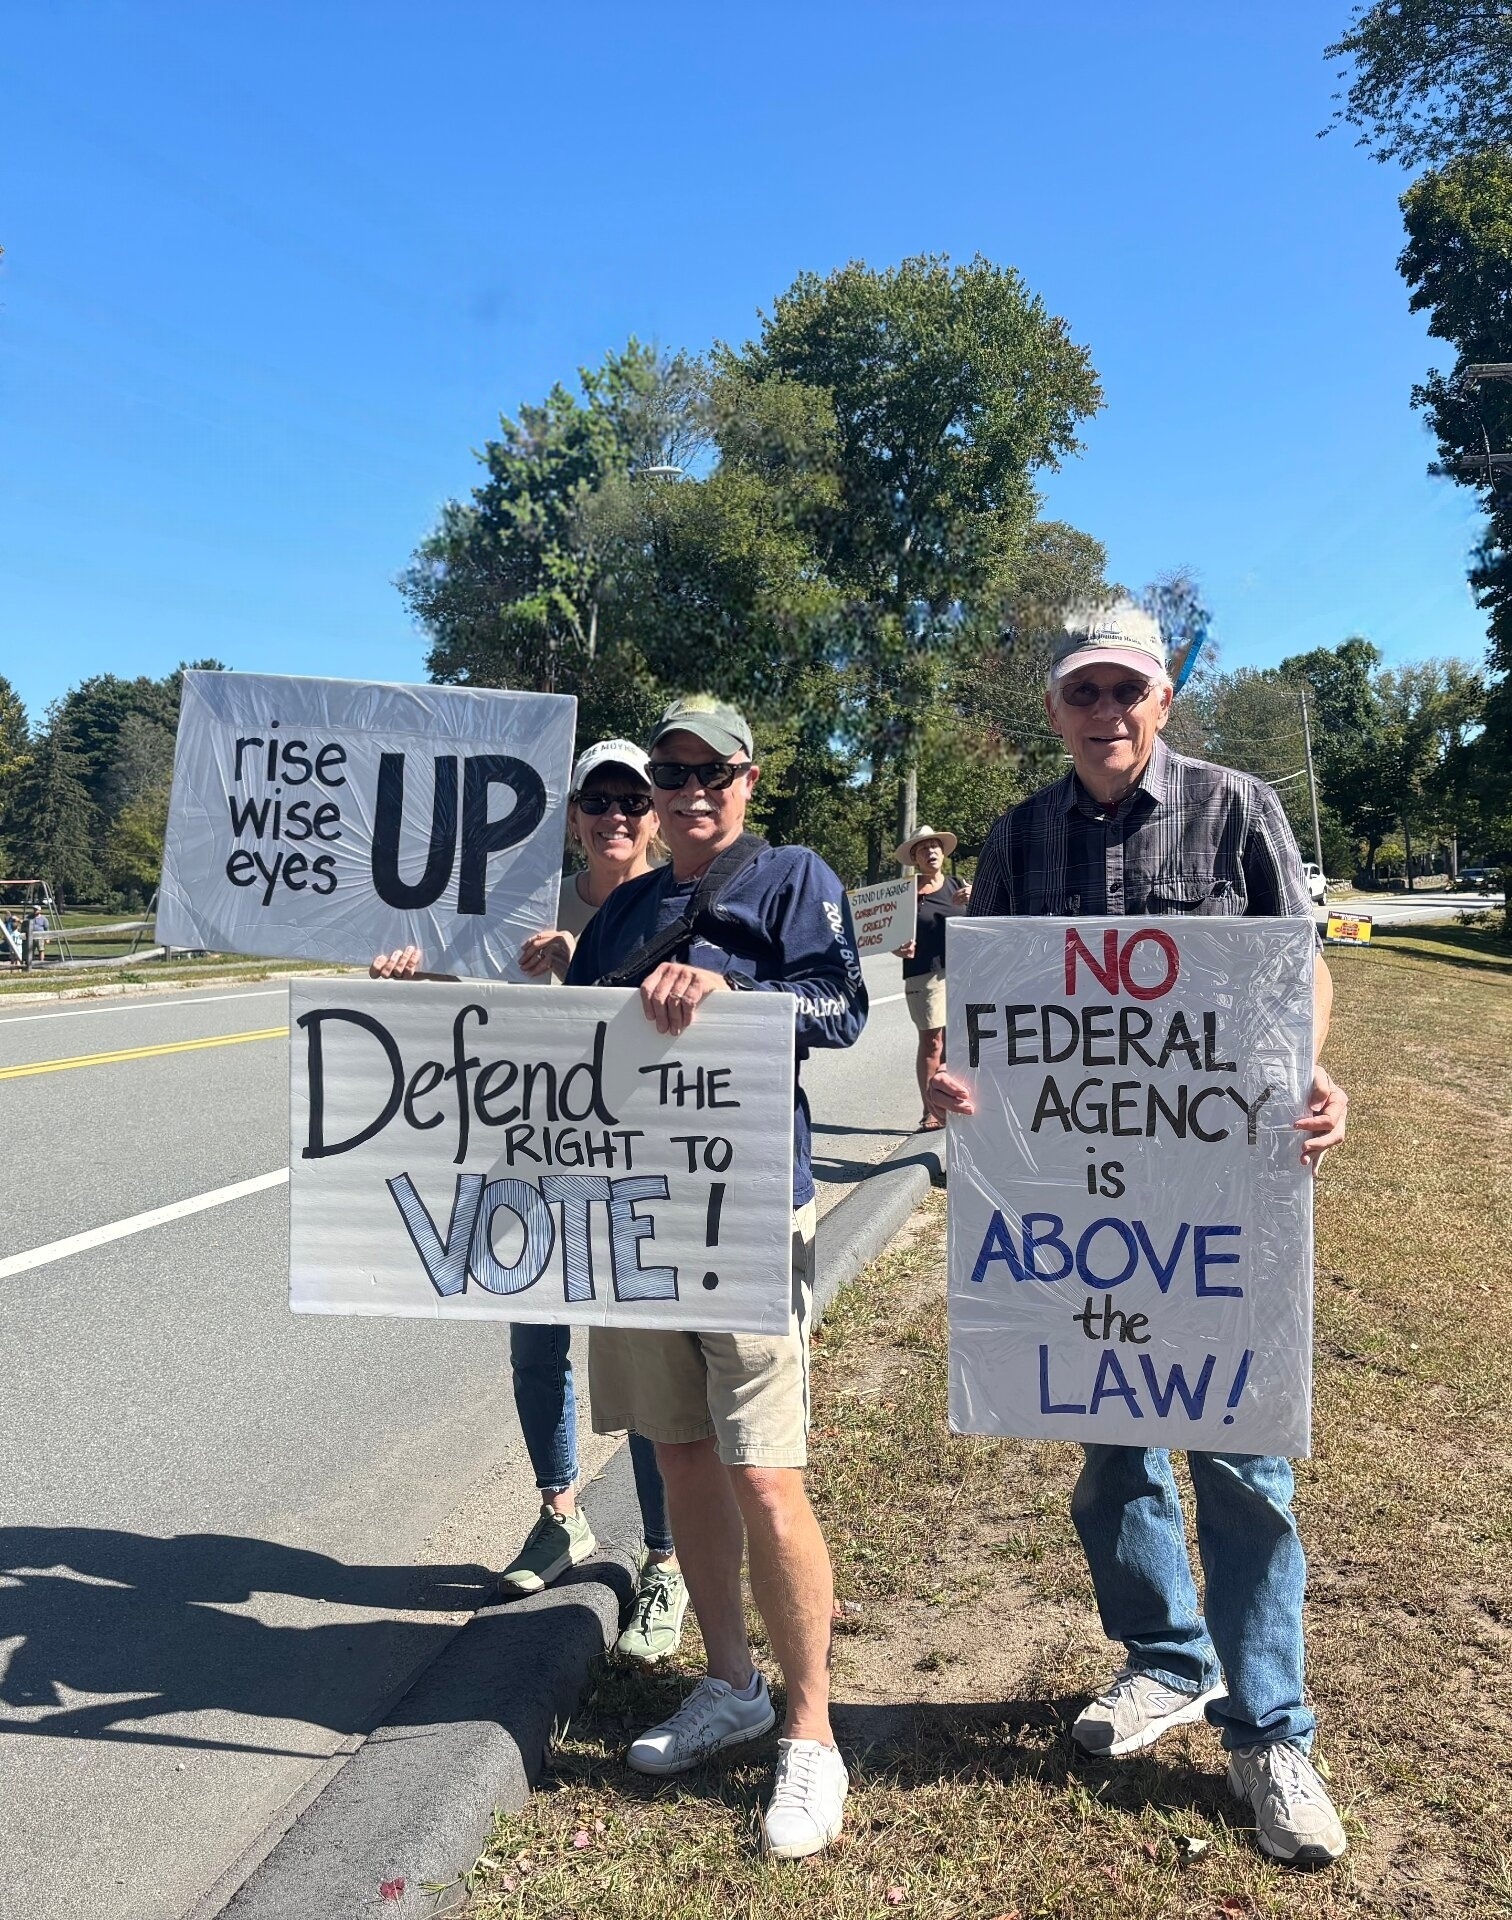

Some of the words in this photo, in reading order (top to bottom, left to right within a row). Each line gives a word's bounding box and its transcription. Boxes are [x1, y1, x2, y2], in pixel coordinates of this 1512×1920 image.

[234, 720, 347, 787] rise
[228, 787, 342, 841] wise
[371, 752, 547, 915] UP
[226, 849, 338, 907] eyes
[851, 890, 876, 907] STAND
[876, 889, 884, 901] UP
[884, 881, 911, 899] AGAINST
[822, 901, 848, 946] 2006
[854, 901, 897, 921] CORRUPTION
[862, 916, 893, 933] CRUELTY
[857, 933, 883, 949] CHAOS
[1065, 927, 1179, 1001] NO
[964, 1003, 1237, 1073] FEDERAL
[296, 1004, 619, 1164] Defend
[638, 1061, 740, 1110] THE
[1030, 1075, 1276, 1146] AGENCY
[505, 1123, 644, 1170] RIGHT
[670, 1135, 733, 1173] TO
[1086, 1146, 1126, 1199] is
[970, 1209, 1244, 1298] ABOVE
[1073, 1294, 1152, 1344] the
[1039, 1344, 1254, 1425] LAW!
